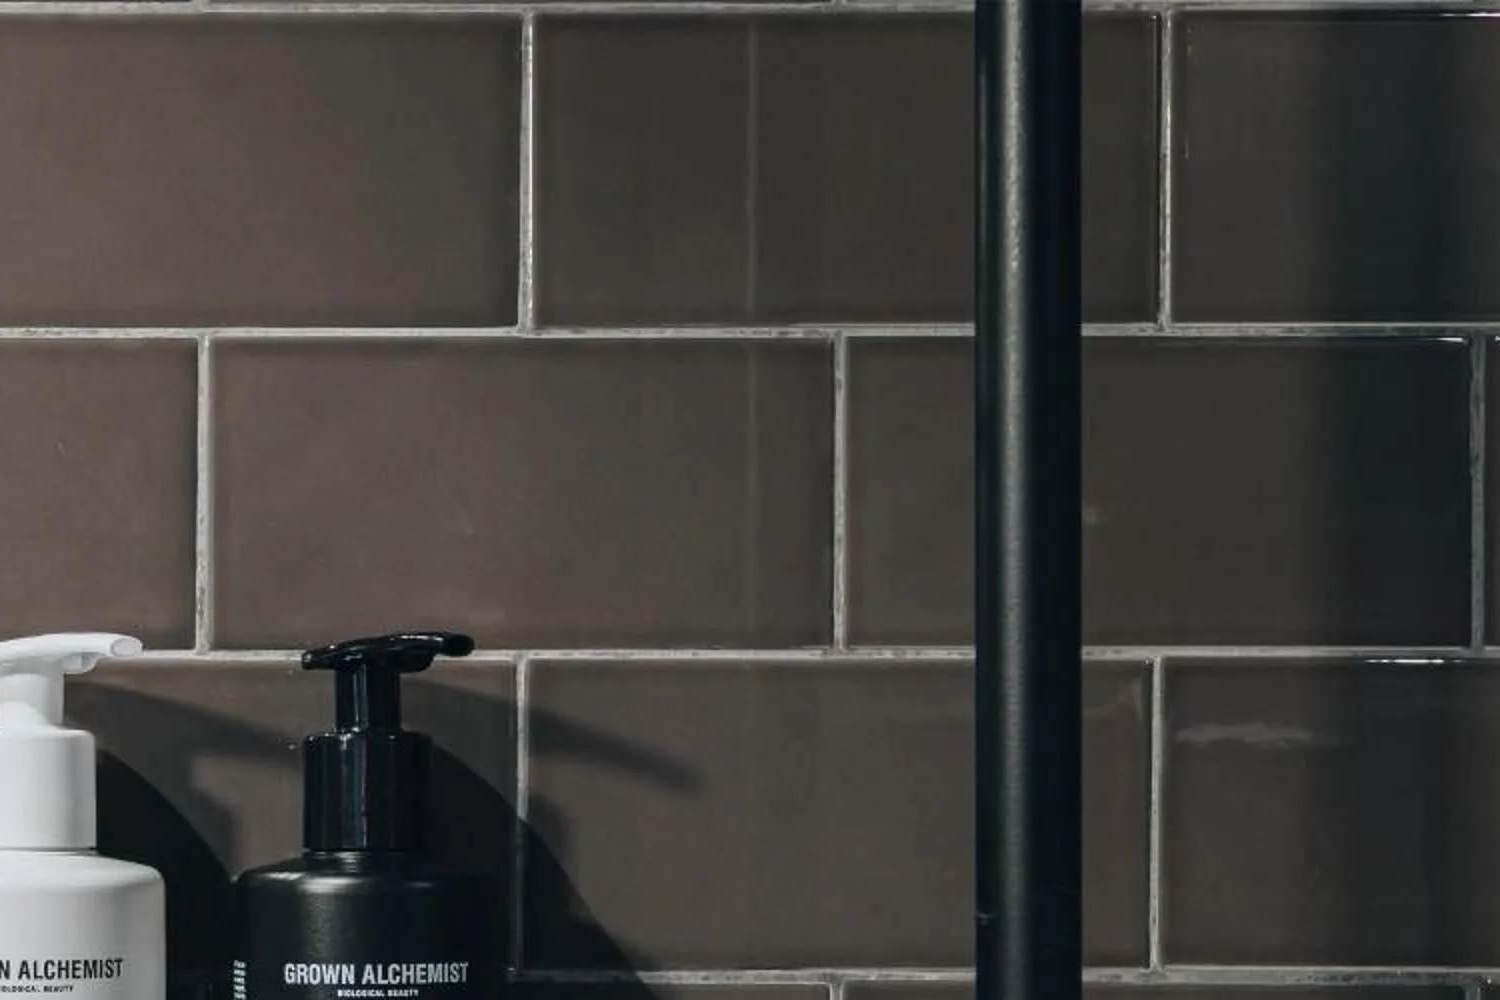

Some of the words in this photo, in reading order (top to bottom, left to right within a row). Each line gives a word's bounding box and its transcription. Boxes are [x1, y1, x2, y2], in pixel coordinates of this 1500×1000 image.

[17, 957, 124, 980] ALCHEMIST
[283, 963, 355, 985] GROWN
[361, 961, 469, 985] ALCHEMIST
[43, 985, 74, 993] BEAUTY
[336, 989, 385, 997] BIOLOGICAL
[387, 989, 419, 997] BEAUTY
